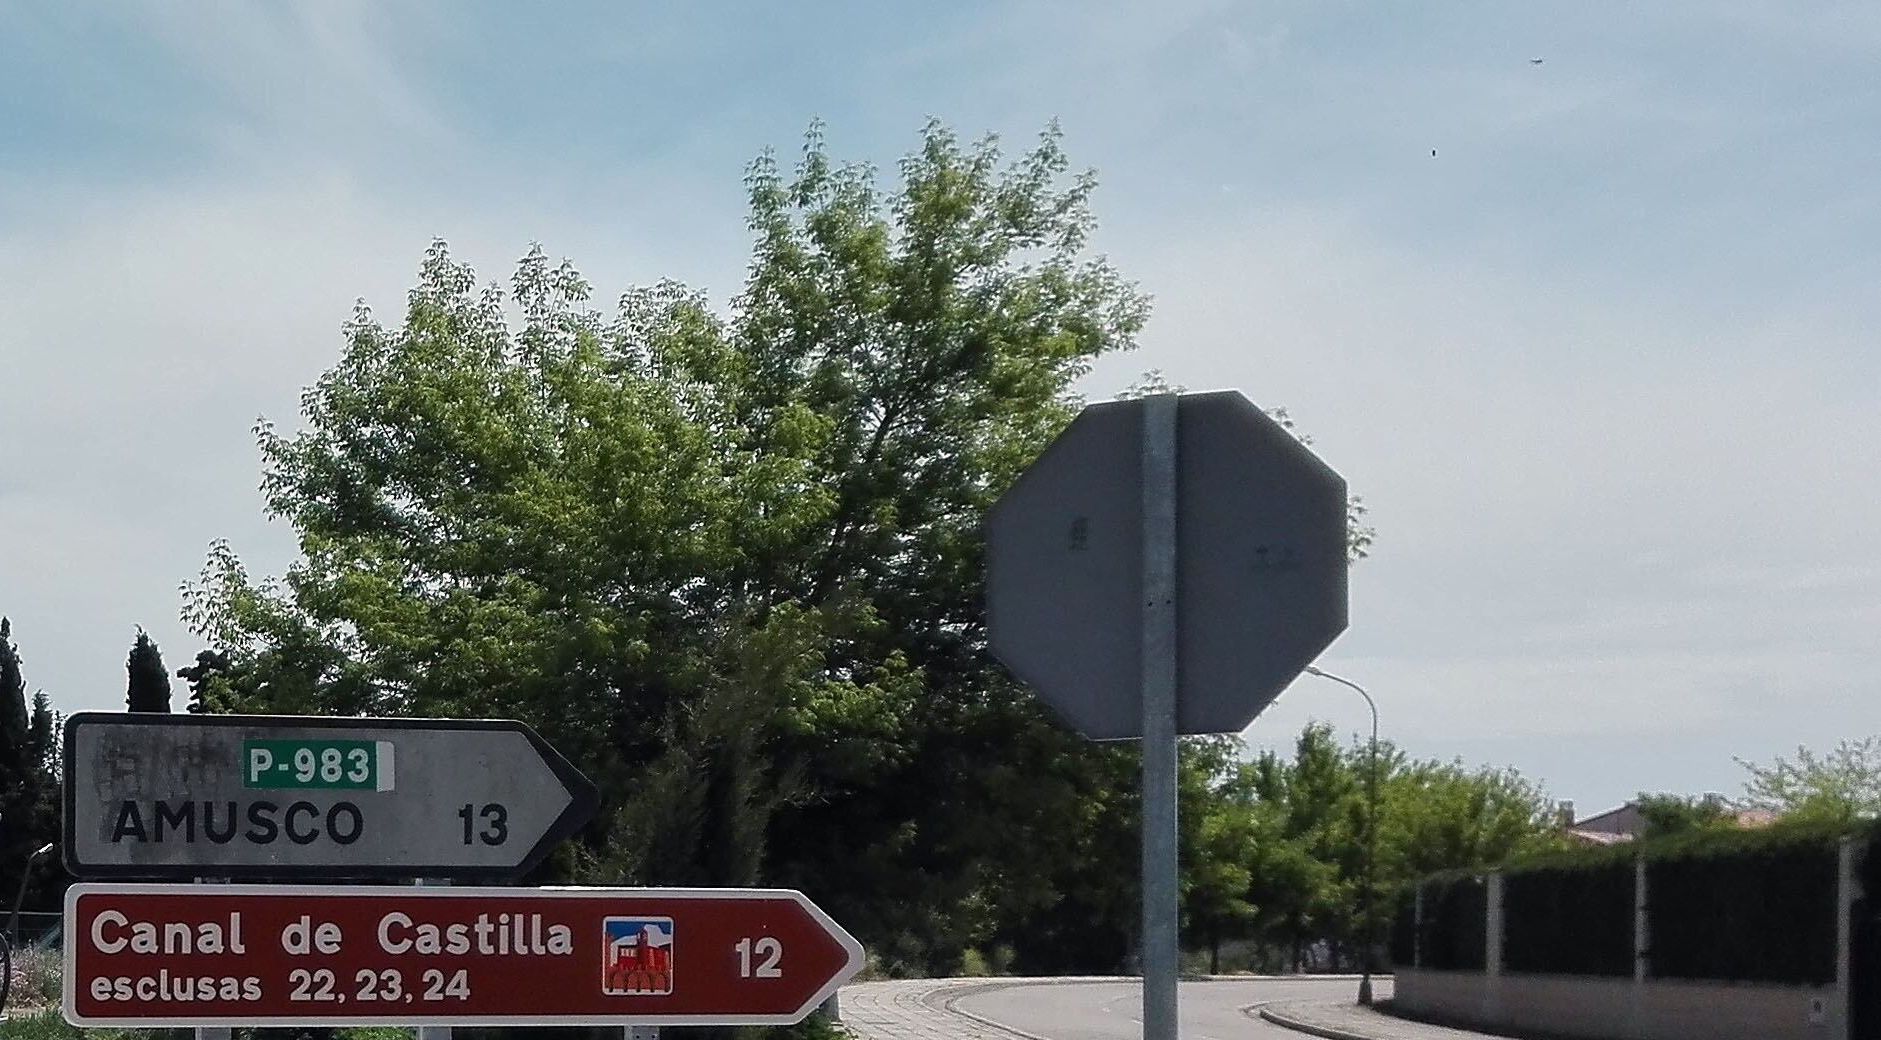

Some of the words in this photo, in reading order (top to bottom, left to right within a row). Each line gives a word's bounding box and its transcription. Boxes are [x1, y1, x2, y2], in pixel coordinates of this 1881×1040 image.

[250, 747, 370, 783] P-983
[111, 800, 364, 846] AMUSCO
[458, 802, 509, 847] 13
[91, 909, 246, 954] Canal
[281, 915, 342, 955] de
[377, 911, 574, 955] Castilla
[735, 936, 783, 978] 12
[90, 968, 262, 1002] esclusas
